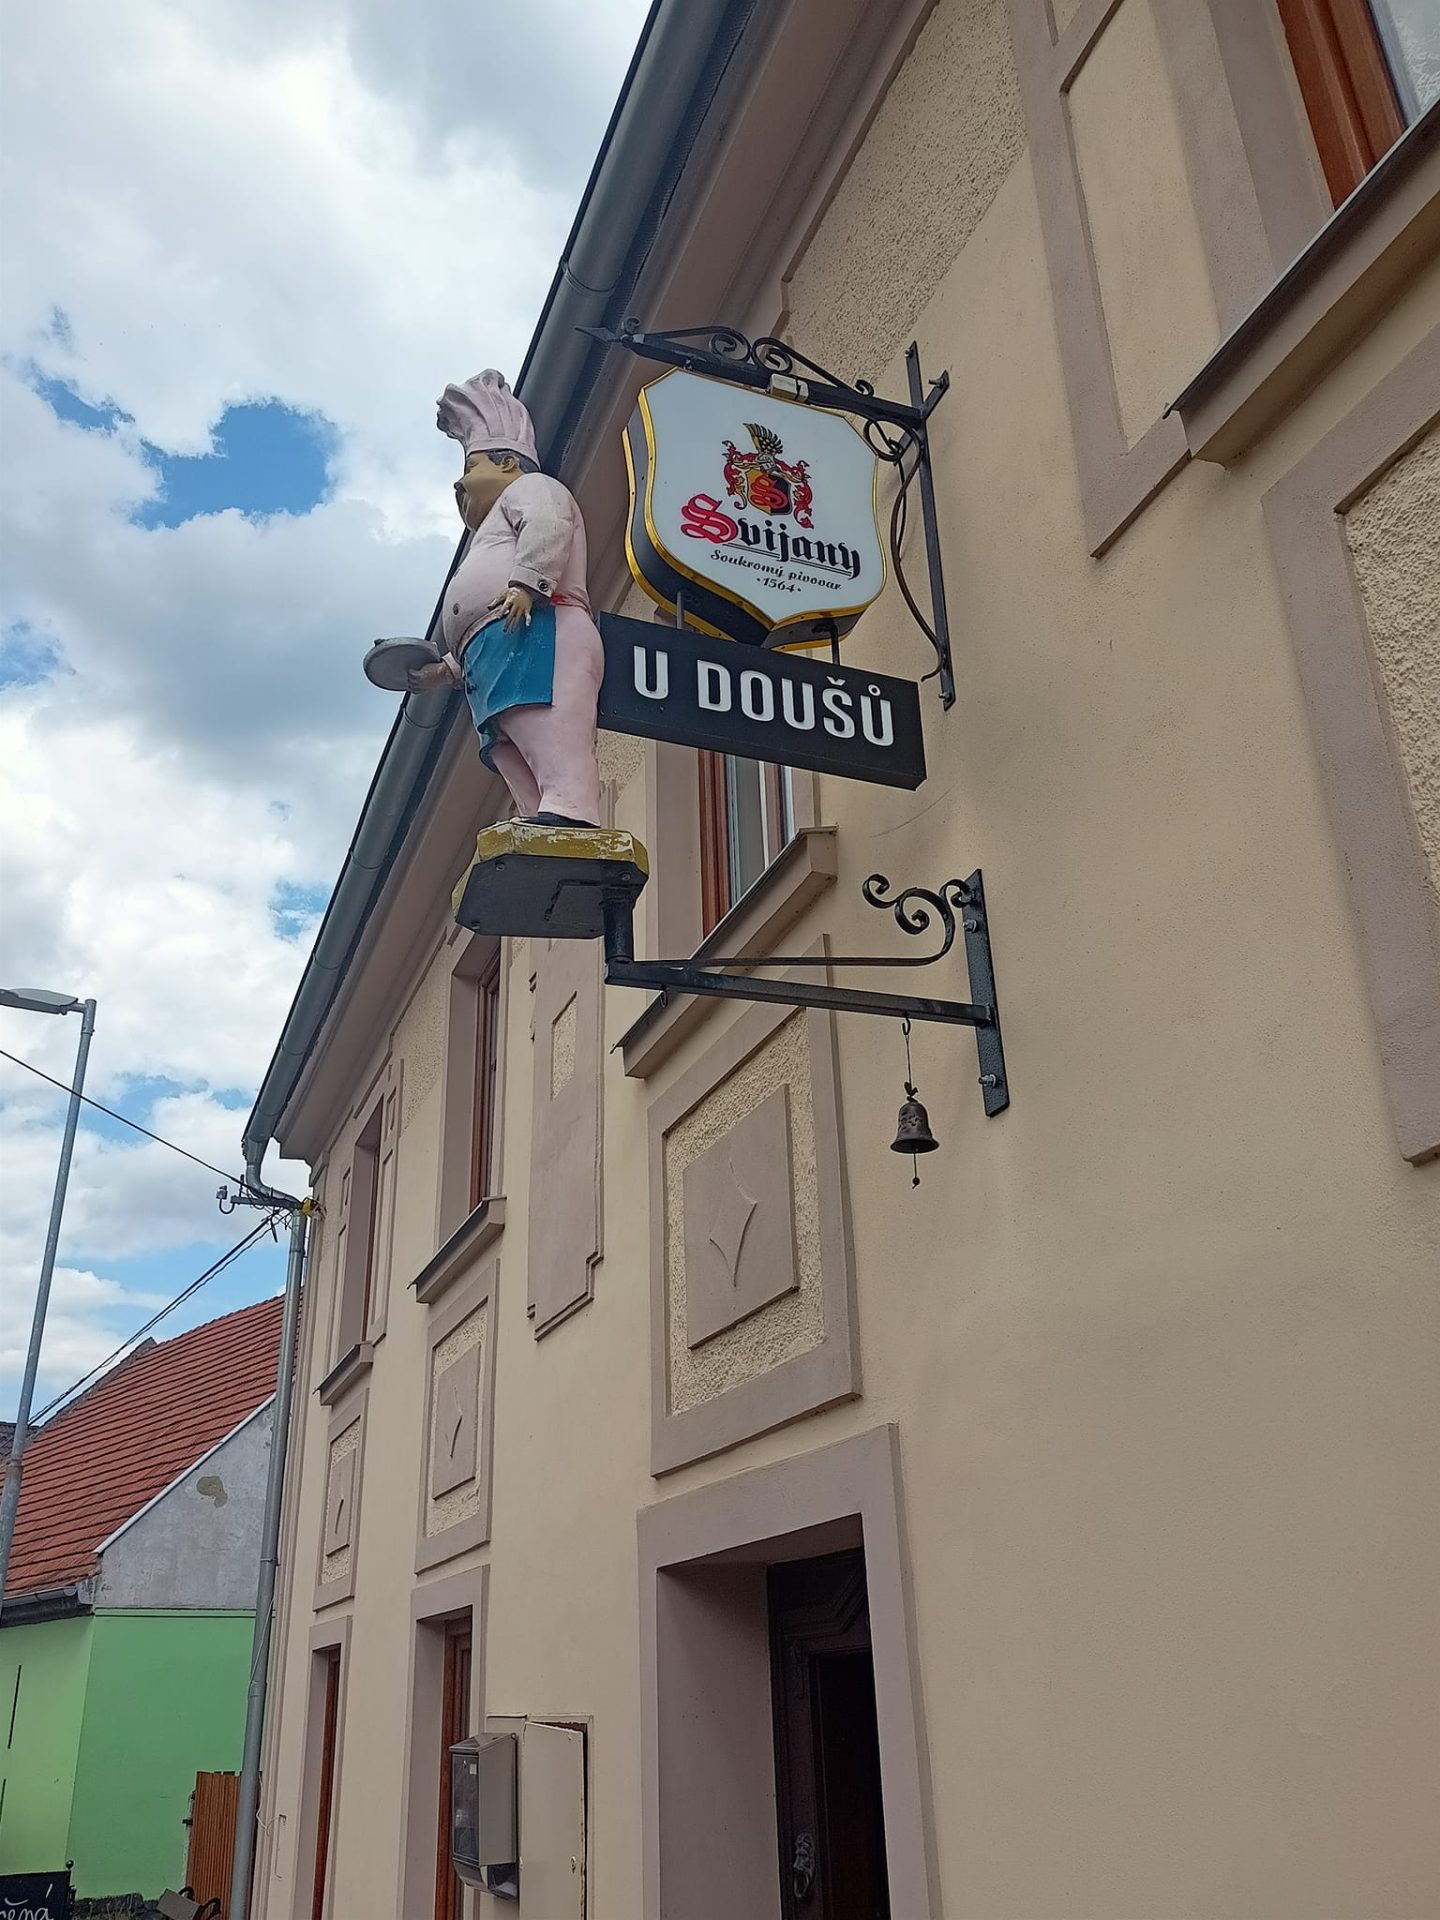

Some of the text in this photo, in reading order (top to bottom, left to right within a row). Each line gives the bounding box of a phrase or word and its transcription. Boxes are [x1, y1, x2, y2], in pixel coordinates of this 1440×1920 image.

[680, 493, 861, 580] Svijany
[710, 549, 842, 591] Soukromý pivovar
[633, 645, 894, 747] U DOUŠŮ
